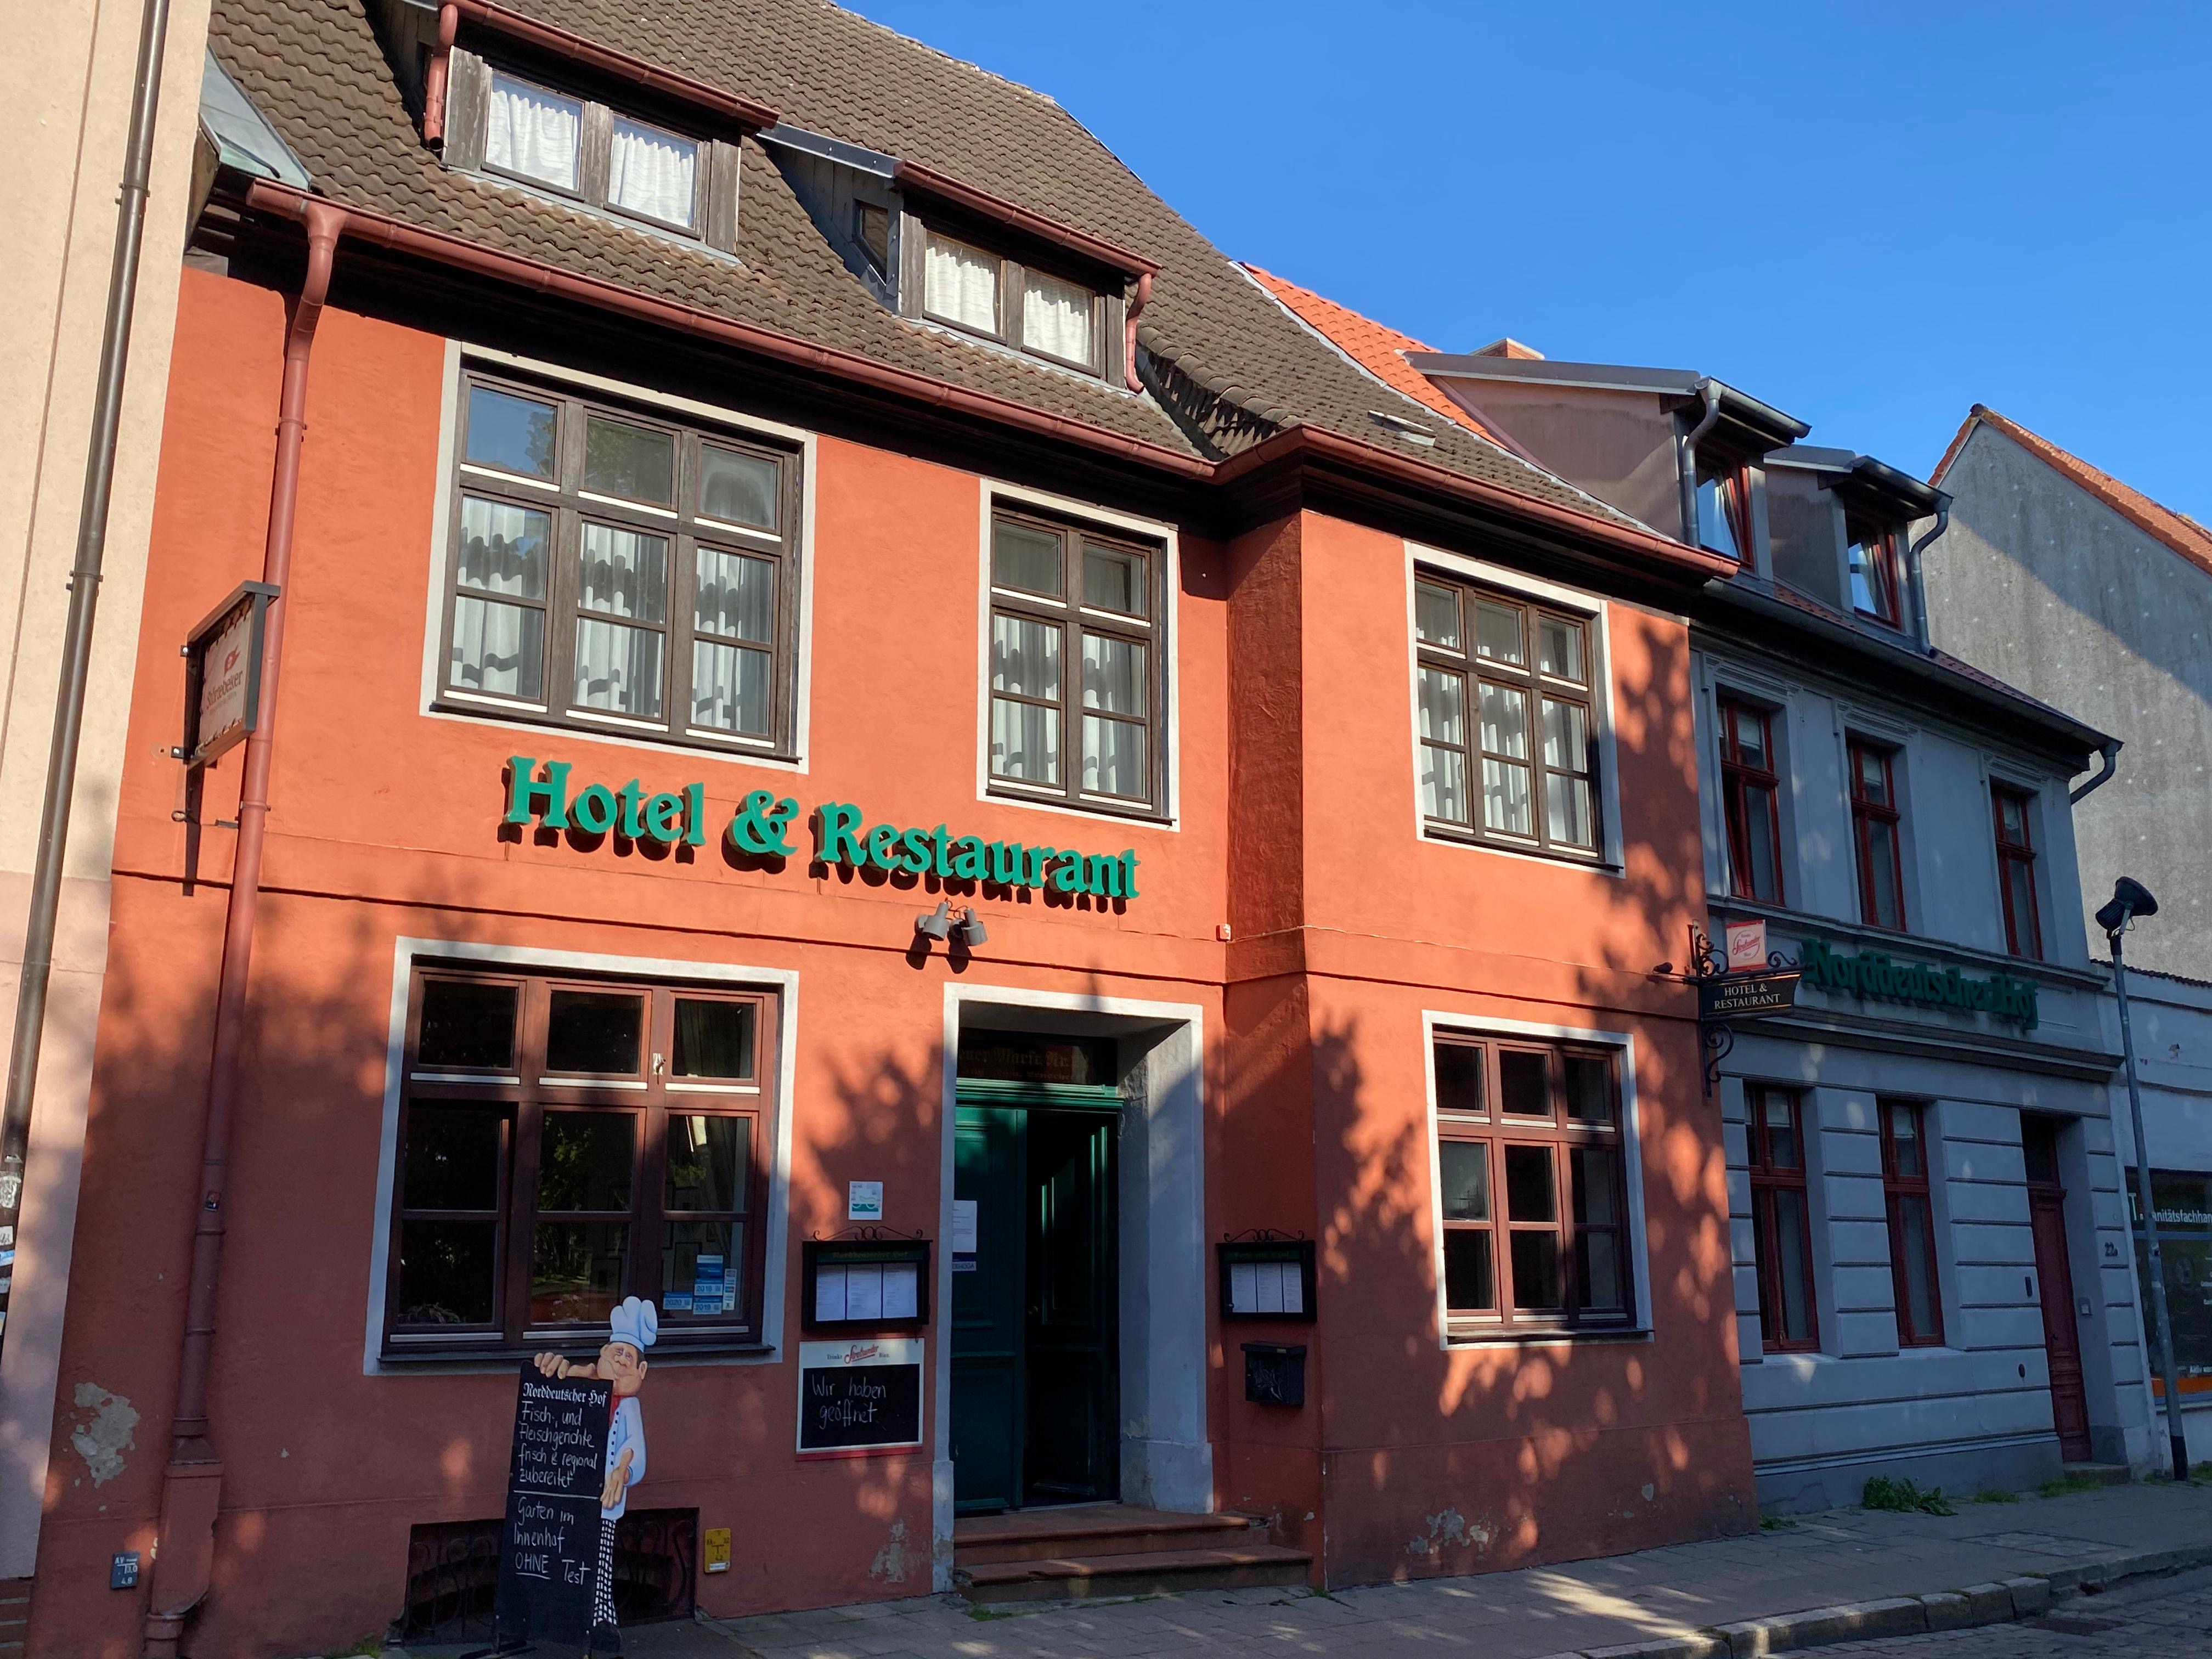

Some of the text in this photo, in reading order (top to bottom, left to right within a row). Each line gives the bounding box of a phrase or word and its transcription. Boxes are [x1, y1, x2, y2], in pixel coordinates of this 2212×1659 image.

[507, 755, 1141, 900] Hotel & Restaurant
[1724, 983, 1768, 996] HOTEL &
[1801, 939, 2039, 1030] Norddeutscher Hof
[1714, 994, 1780, 1009] RESTAURANT
[2151, 1208, 2212, 1224] anitätsfachhan
[523, 1383, 608, 1408] Norddeutscher Hof
[812, 1374, 887, 1400] Wir haben
[562, 1408, 582, 1426] und
[518, 1420, 595, 1451] Fleischgerichte
[518, 1443, 547, 1467] frisch
[562, 1453, 598, 1475] regional
[519, 1465, 574, 1488] zubereitet
[518, 1496, 574, 1526] Garten im
[514, 1523, 566, 1554] Innenhof
[515, 1551, 591, 1585] OHNE Test
